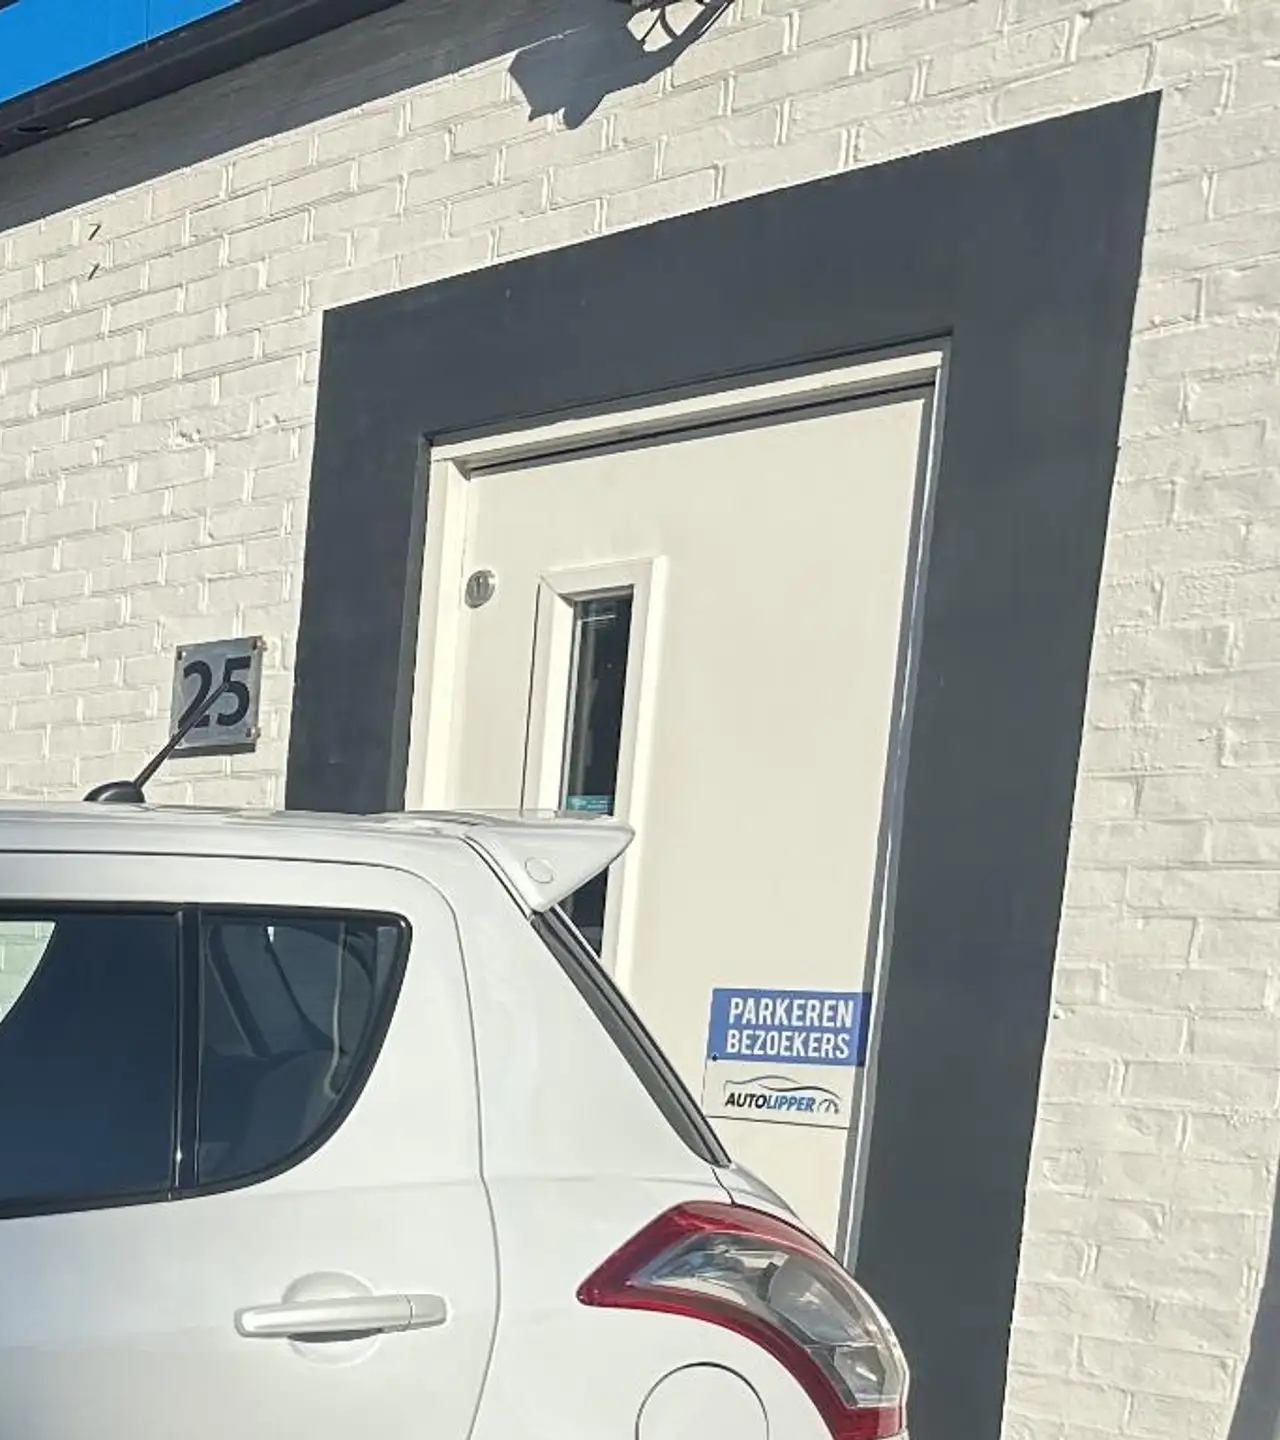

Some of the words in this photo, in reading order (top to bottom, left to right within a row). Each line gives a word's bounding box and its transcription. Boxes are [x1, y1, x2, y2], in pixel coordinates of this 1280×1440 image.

[177, 656, 251, 728] 25
[728, 997, 854, 1028] PARKEREN
[726, 1029, 850, 1059] BEZOEKERS
[724, 1092, 816, 1114] AUTOLIPPER
